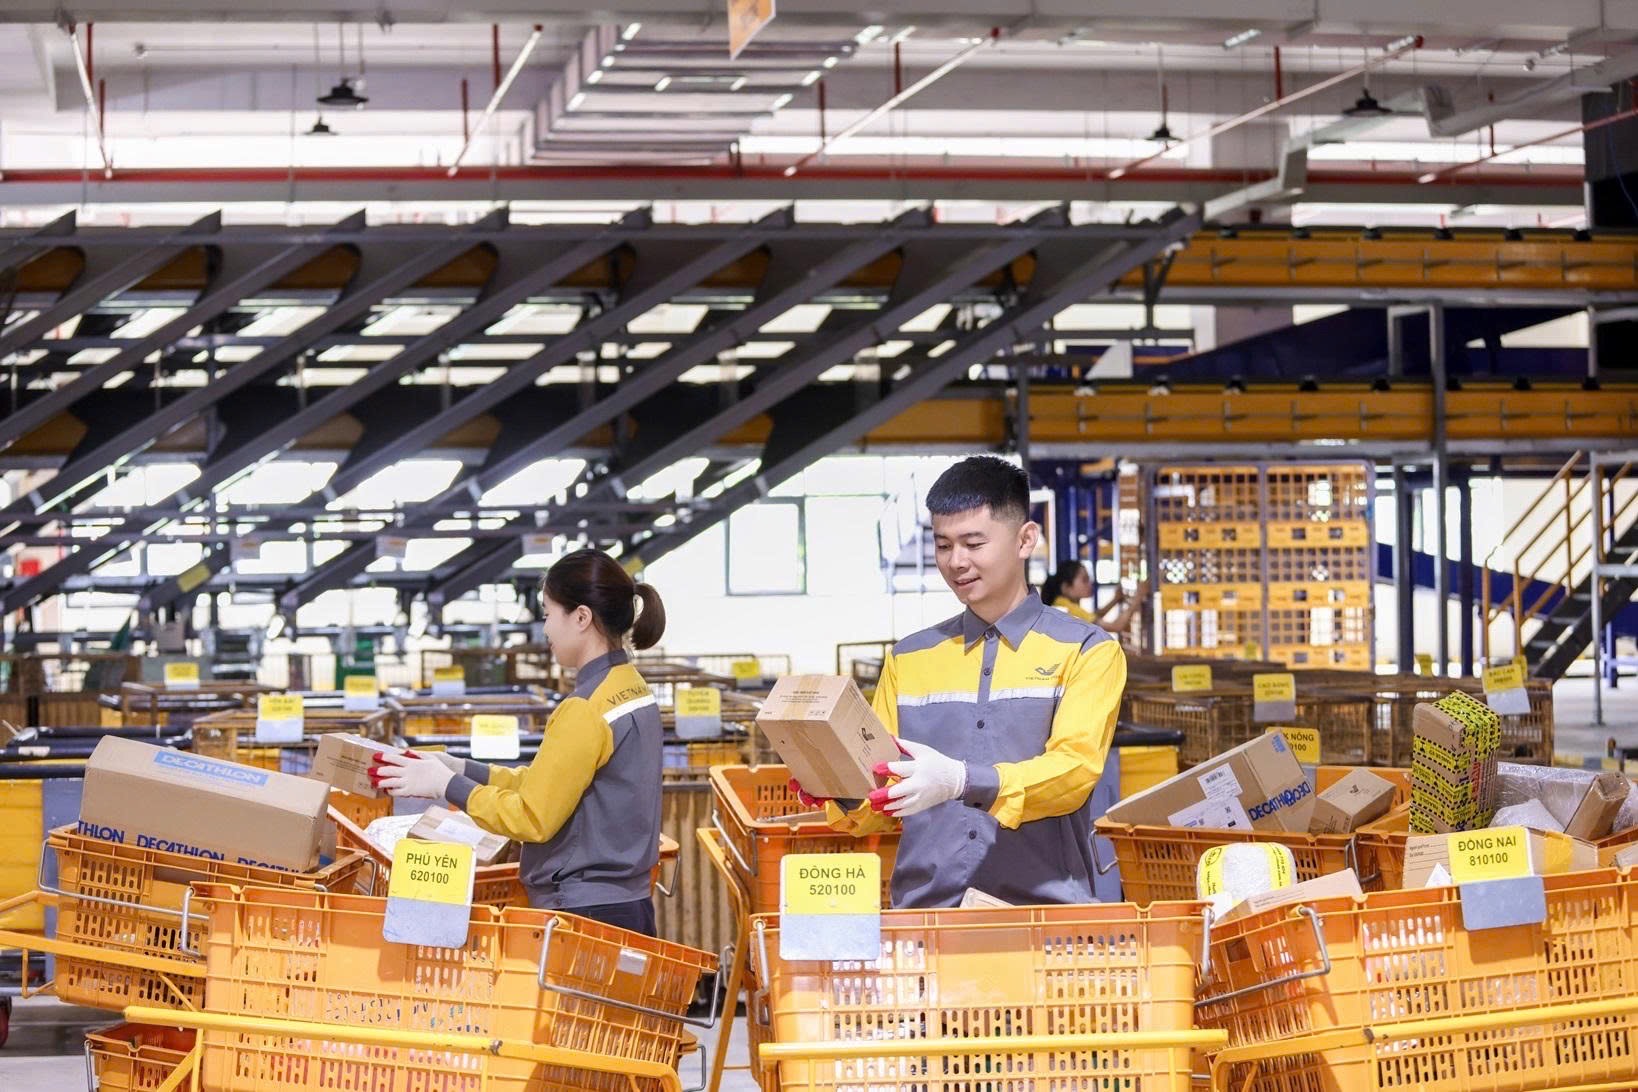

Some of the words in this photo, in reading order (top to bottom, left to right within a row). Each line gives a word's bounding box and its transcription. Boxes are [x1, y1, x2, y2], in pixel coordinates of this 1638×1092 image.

[1290, 743, 1307, 751] 0100
[160, 753, 262, 785] DECATHLON
[1496, 835, 1517, 848] NAI
[434, 853, 458, 869] YÊN
[1469, 852, 1508, 867] 810100
[410, 869, 450, 885] 620100
[809, 884, 856, 896] 520100
